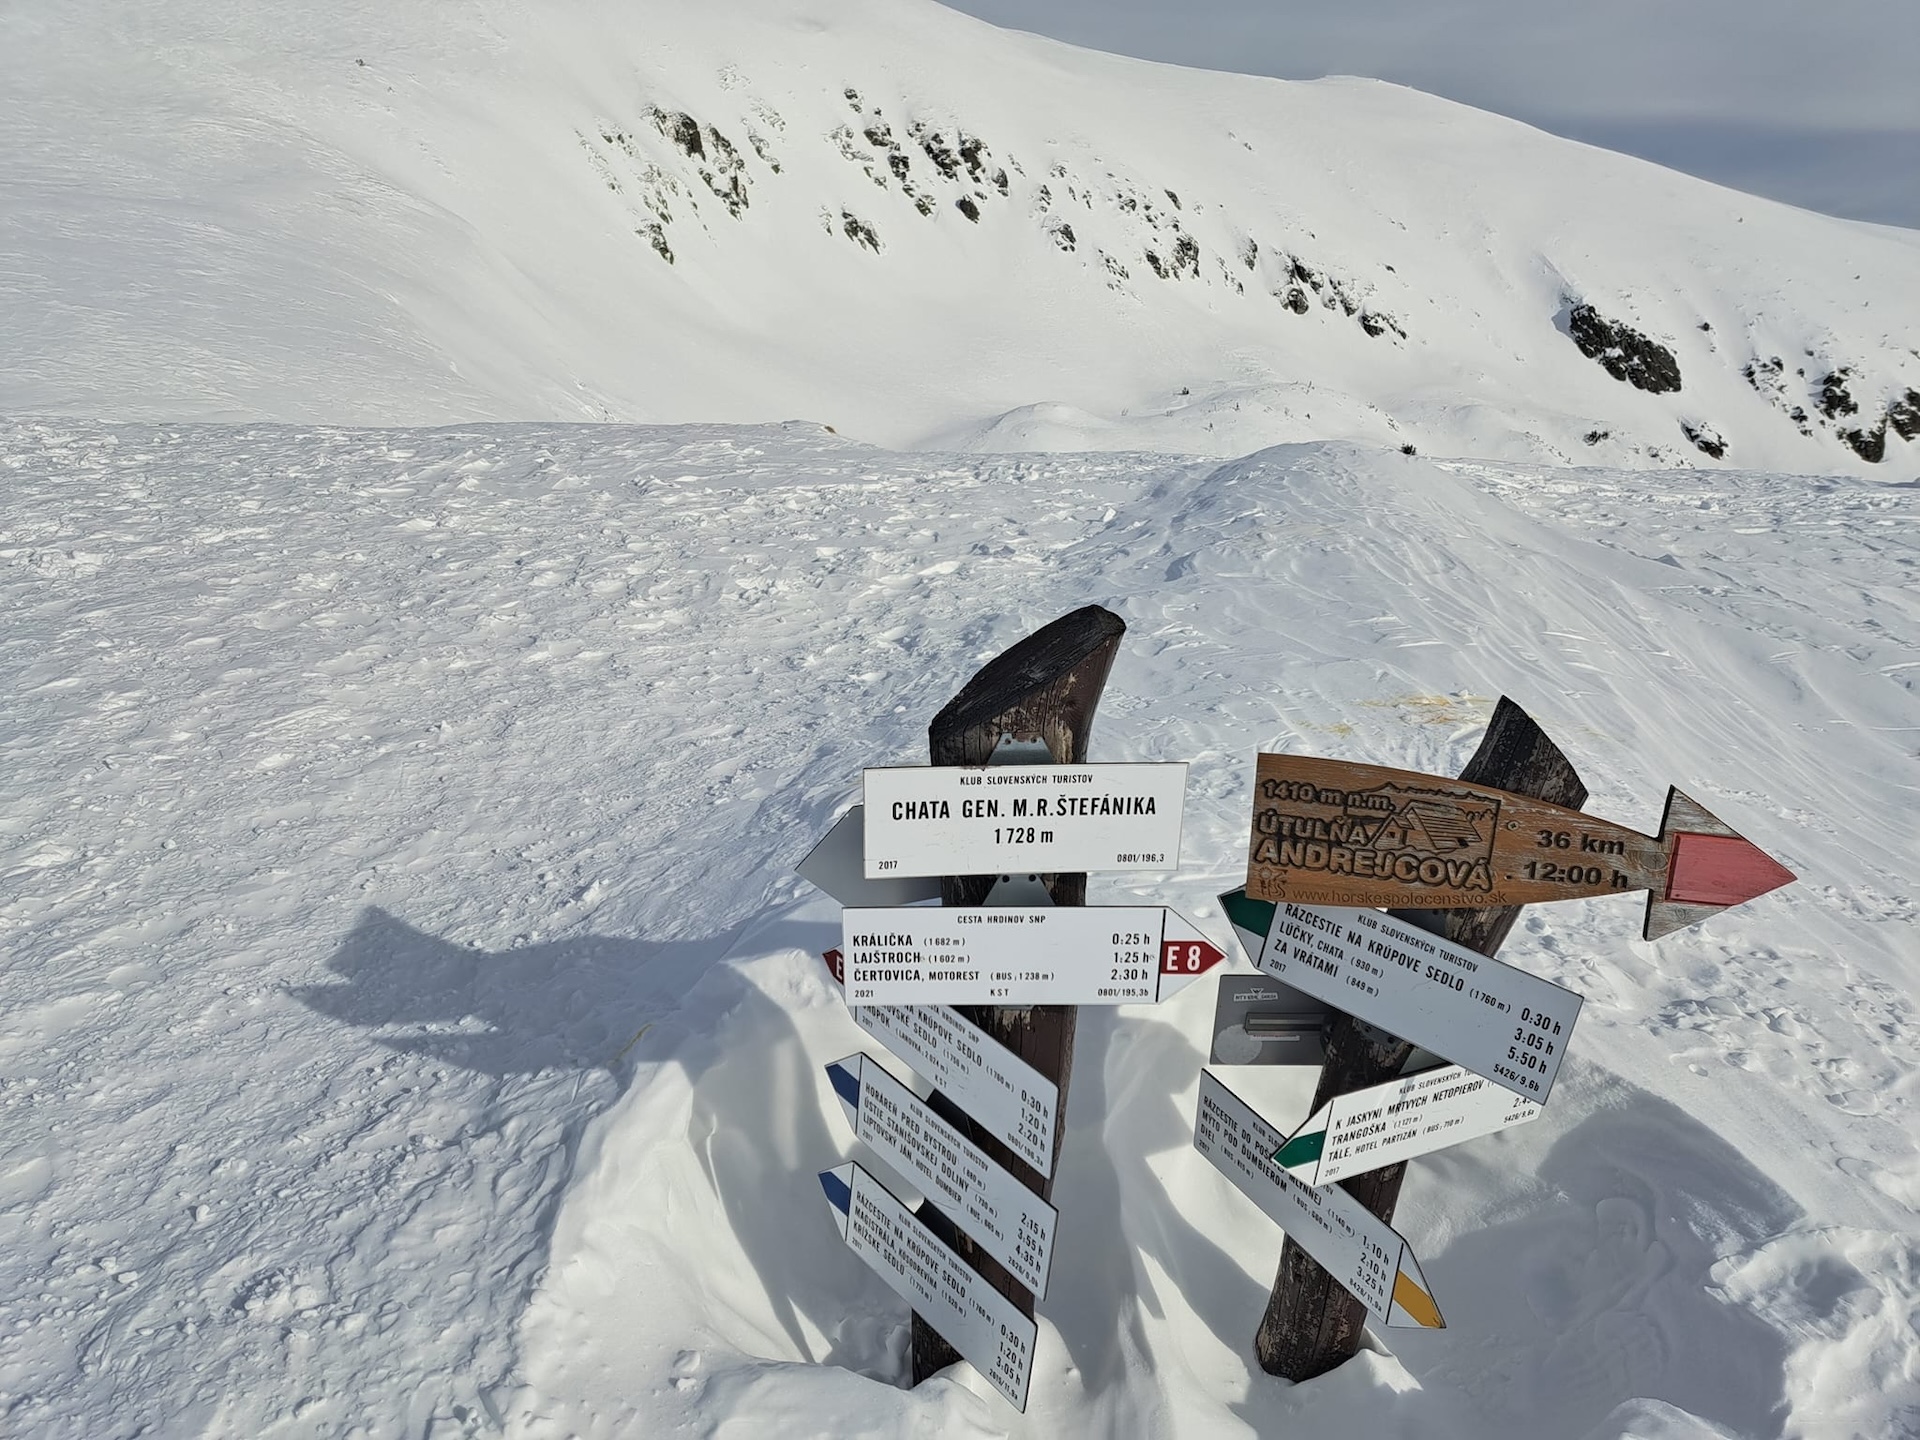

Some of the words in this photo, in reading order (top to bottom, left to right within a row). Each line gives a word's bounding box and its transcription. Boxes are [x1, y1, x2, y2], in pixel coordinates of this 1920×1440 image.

[959, 776, 982, 785] KLUB
[986, 775, 1047, 785] SLOVENSKÝCH
[1052, 774, 1093, 784] TURISTOV
[1263, 779, 1315, 801] 1410
[1319, 788, 1342, 804] m
[1347, 792, 1396, 812] n.m.
[892, 800, 950, 821] CHATA
[962, 799, 1005, 818] GEN.
[1040, 830, 1053, 843] m
[1259, 808, 1369, 846] ÚTULŇA
[1537, 829, 1571, 850] 36
[1581, 832, 1625, 855] km
[878, 860, 898, 870] 2017
[1254, 838, 1493, 892] ANDREJCOVÁ
[1523, 861, 1602, 886] 12:00
[1610, 869, 1628, 889] h
[1291, 889, 1506, 906] www.horskespolocenstvo.sk
[957, 915, 982, 924] CESTA
[987, 915, 1024, 923] HRDINOV
[1029, 915, 1046, 924] SNP
[852, 932, 912, 947] KRÁLIČKA
[1112, 933, 1140, 945] 0:25
[1143, 933, 1150, 945] h
[1357, 914, 1378, 930] KLUB
[1380, 924, 1436, 955] SLOVENSKÝCH
[1439, 948, 1479, 972] TURISTOV
[853, 950, 921, 964] LAJŠTROCH
[1114, 951, 1139, 963] 1:25
[1142, 952, 1149, 963] h
[1166, 946, 1180, 971] E
[1187, 945, 1201, 971] 8
[1269, 958, 1287, 972] 2017
[1284, 902, 1343, 938] RÁZCESTIE
[1346, 930, 1362, 947] NA
[1367, 939, 1421, 973] KRÚPOVE
[1425, 965, 1464, 992] SEDLO
[1520, 1007, 1551, 1030] 0:30
[1552, 1021, 1561, 1035] h
[854, 968, 924, 982] ČERTOVICA,
[928, 970, 979, 981] MOTOREST
[1110, 968, 1138, 980] 2:30
[1141, 969, 1148, 980] h
[1279, 920, 1314, 948] LÚČKY,
[1316, 939, 1344, 960] CHATA
[1514, 1027, 1544, 1050] 3:05
[1545, 1041, 1554, 1055] h
[854, 989, 874, 998] 2021
[1273, 938, 1287, 954] ZA
[1293, 946, 1338, 977] VRÁTAMI
[1507, 1045, 1537, 1069] 5:50
[1538, 1060, 1547, 1074] h
[913, 1022, 937, 1048] SEDLO
[1021, 1107, 1040, 1130] 1:20
[1041, 1123, 1047, 1136] h
[917, 1008, 952, 1044] KRÚPOVE
[956, 1039, 982, 1067] SEDLO
[1021, 1089, 1041, 1113] 0:30
[1042, 1106, 1048, 1119] h
[1335, 1119, 1342, 1130] K
[1346, 1107, 1383, 1127] JASKYNI
[1432, 1076, 1486, 1102] NETOPIEROV
[909, 1102, 923, 1118] KLUB
[925, 1115, 961, 1149] SLOVENSKÝCH
[963, 1145, 988, 1172] TURISTOV
[1018, 1122, 1038, 1146] 2:20
[1039, 1139, 1045, 1152] h
[1328, 1146, 1352, 1162] TÁLE,
[1354, 1140, 1377, 1154] HOTEL
[1381, 1128, 1417, 1146] PARTIZÁN
[1332, 1121, 1386, 1146] TRANGOŠKA
[864, 1096, 883, 1121] ÚSTIE
[886, 1116, 938, 1166] STANIŠOVSKEJ
[941, 1162, 969, 1192] DOLINY
[1017, 1227, 1036, 1251] 3:55
[1037, 1244, 1043, 1258] h
[865, 1082, 898, 1116] HORÁREŇ
[900, 1111, 920, 1135] PRED
[923, 1130, 957, 1166] BYSTROU
[1020, 1212, 1039, 1235] 2:15
[1040, 1228, 1046, 1241] h
[1324, 1166, 1340, 1177] 2017
[863, 1111, 897, 1148] LIPTOVSKÝ
[899, 1143, 914, 1164] JÁN,
[915, 1158, 932, 1180] HOTEL
[1015, 1244, 1034, 1267] 4:35
[1035, 1260, 1041, 1273] h
[1202, 1109, 1220, 1132] MÝTO
[1223, 1128, 1238, 1148] POD
[1241, 1143, 1287, 1192] ĎUMBIEROM
[1360, 1252, 1379, 1275] 2:10
[1380, 1269, 1386, 1282] h
[1203, 1095, 1238, 1133] RÁZCESTIE
[1241, 1128, 1251, 1144] DO
[1363, 1235, 1382, 1259] 1:10
[1383, 1253, 1389, 1265] h
[1200, 1123, 1215, 1144] DIEL
[1356, 1265, 1377, 1290] 3:25
[1378, 1284, 1384, 1297] h
[856, 1190, 891, 1230] RÁZCESTIE
[893, 1225, 903, 1241] NA
[906, 1236, 939, 1274] KRÚPOVE
[941, 1269, 966, 1298] SEDLO
[1000, 1323, 1019, 1348] 0:30
[1020, 1341, 1025, 1354] h
[853, 1220, 880, 1253] KRÍŽSKE
[883, 1248, 905, 1275] SEDLO
[996, 1355, 1014, 1379] 3:05
[1015, 1373, 1021, 1386] h
[999, 1341, 1017, 1364] 1:20
[1017, 1358, 1023, 1371] h
